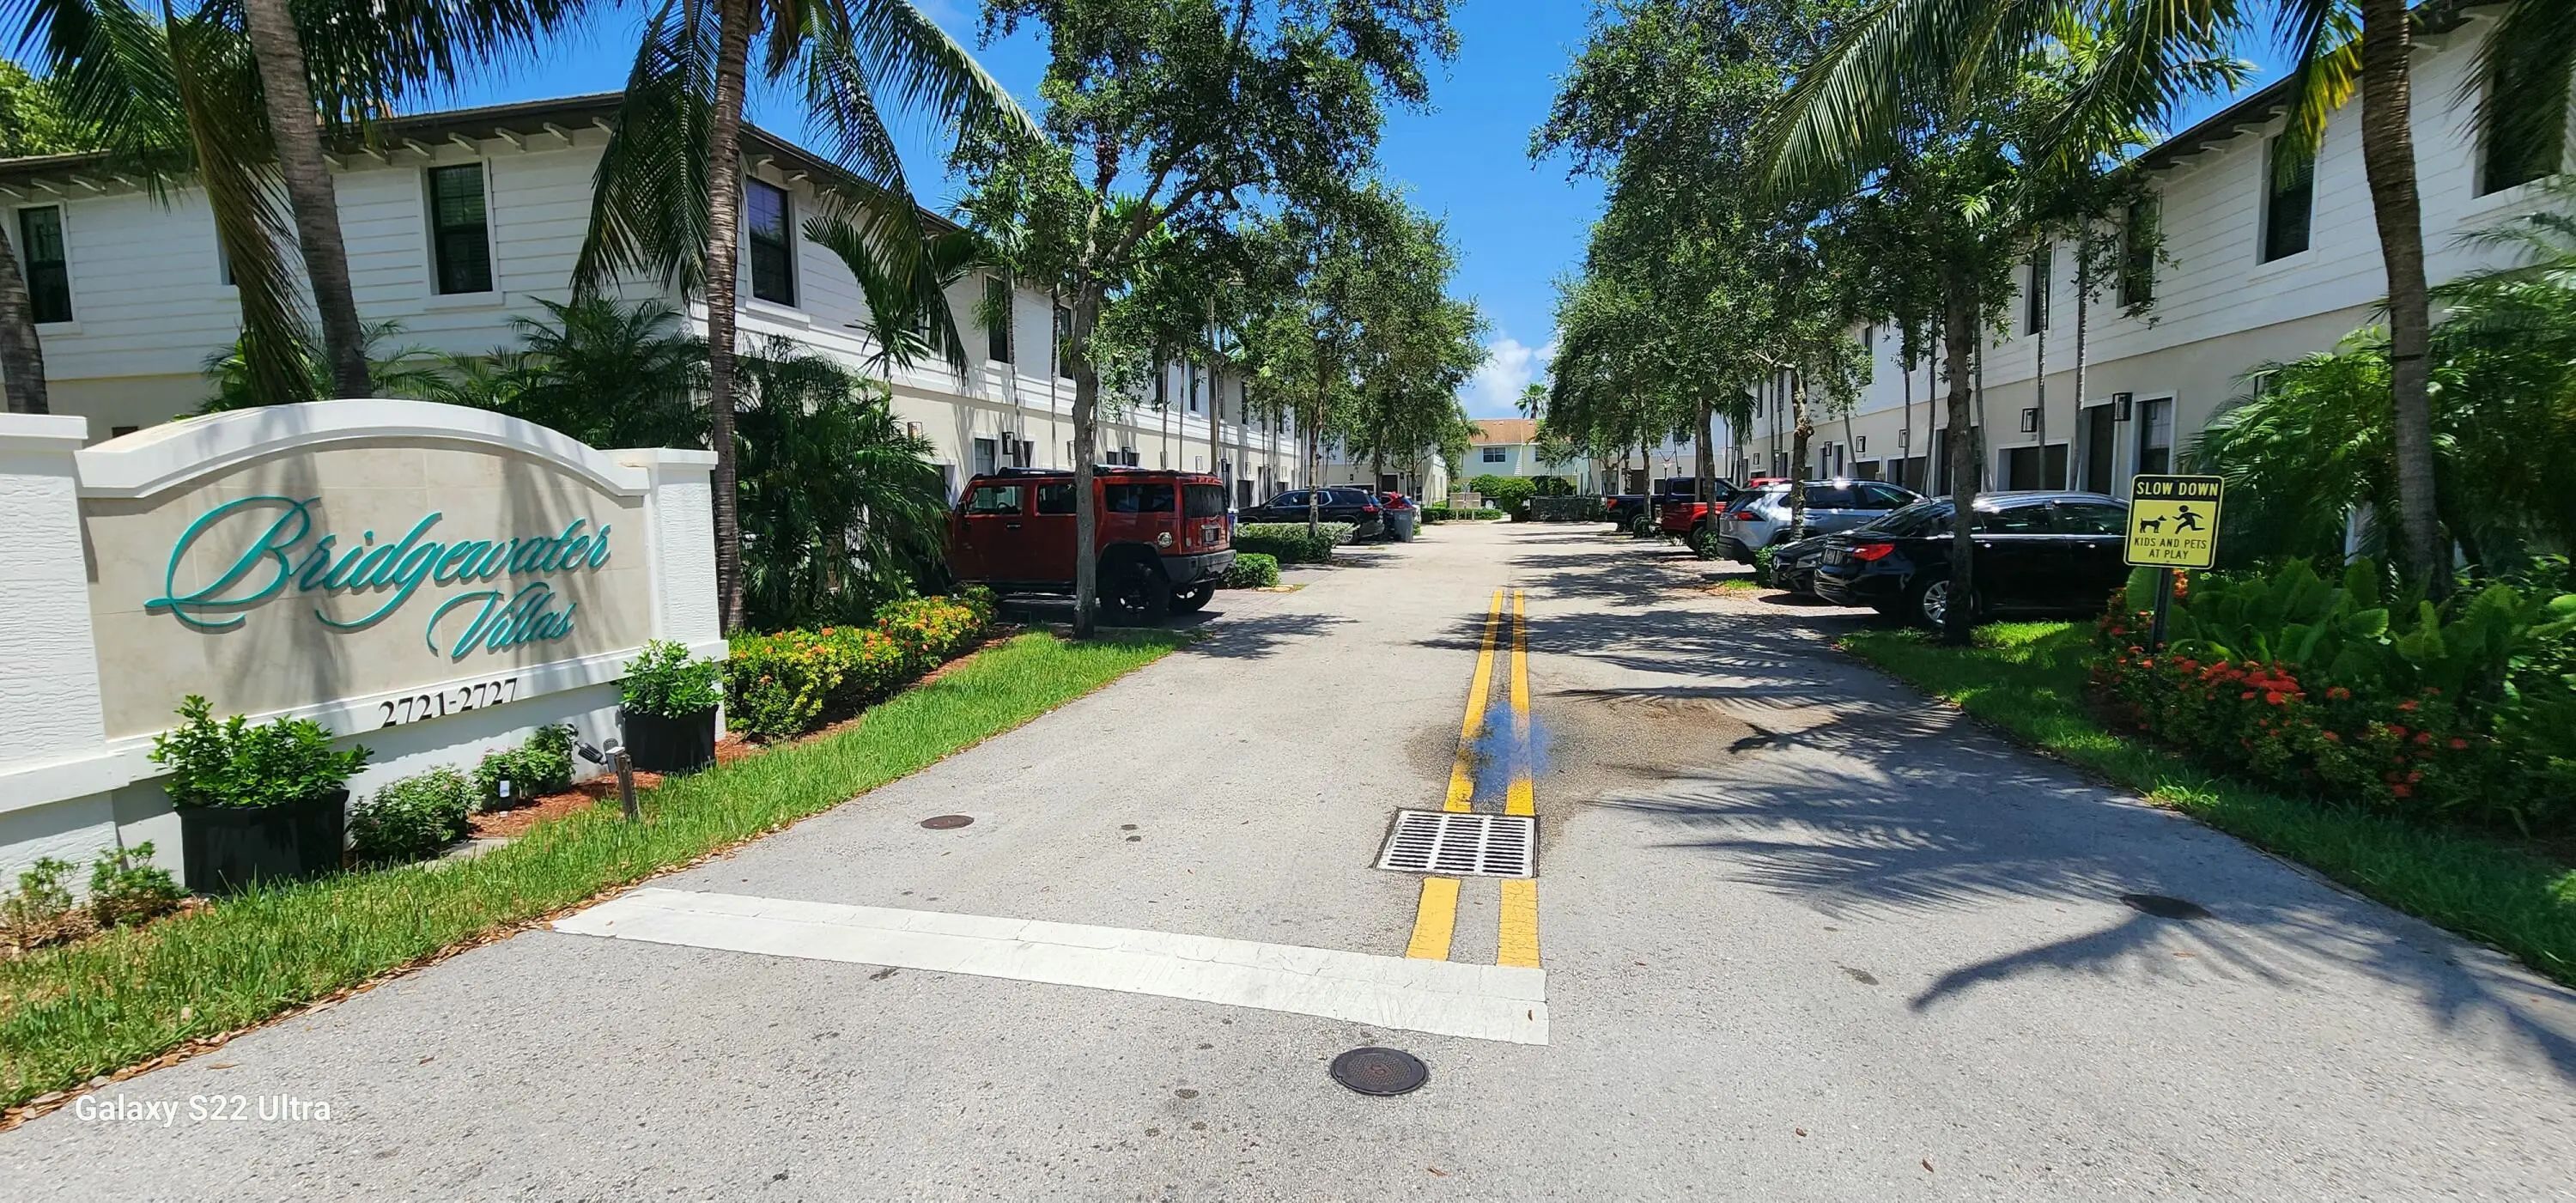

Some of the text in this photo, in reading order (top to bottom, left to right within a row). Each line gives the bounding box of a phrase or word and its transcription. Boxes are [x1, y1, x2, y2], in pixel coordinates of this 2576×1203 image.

[2136, 482, 2219, 496] SLOW DOWN
[2134, 537, 2207, 550] KIDS AND PETS
[2148, 549, 2189, 559] AT PLAY
[144, 495, 612, 629] Bridgewater
[427, 580, 576, 659] Villas
[379, 677, 517, 728] 2721-2727
